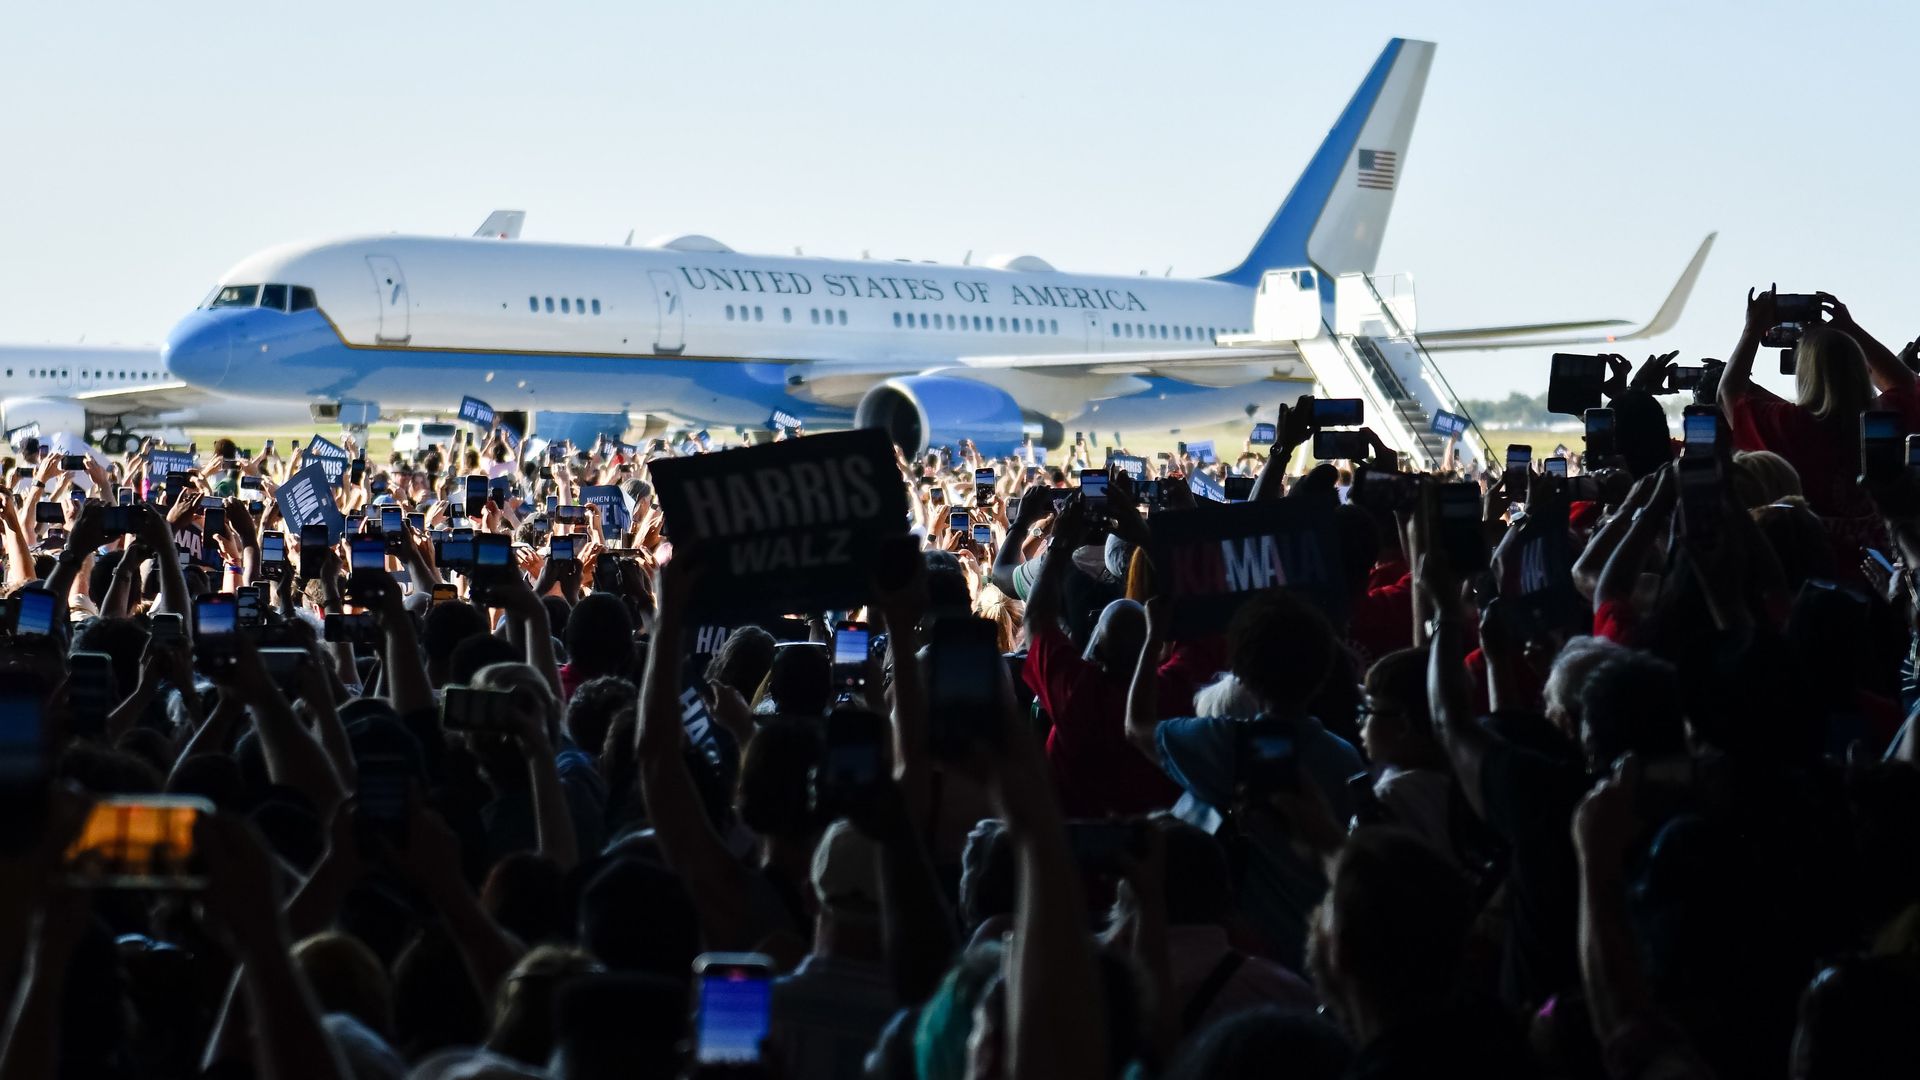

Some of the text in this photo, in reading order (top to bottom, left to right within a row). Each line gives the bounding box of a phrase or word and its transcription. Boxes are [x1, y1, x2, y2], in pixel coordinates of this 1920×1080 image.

[679, 266, 1148, 312] UNITED STATES OF AMERICA
[152, 461, 168, 475] WE
[286, 492, 298, 515] FIGHT
[292, 477, 319, 520] WIN
[586, 495, 610, 503] WHEN
[681, 454, 881, 538] HARRIS
[729, 528, 851, 576] WALZ
